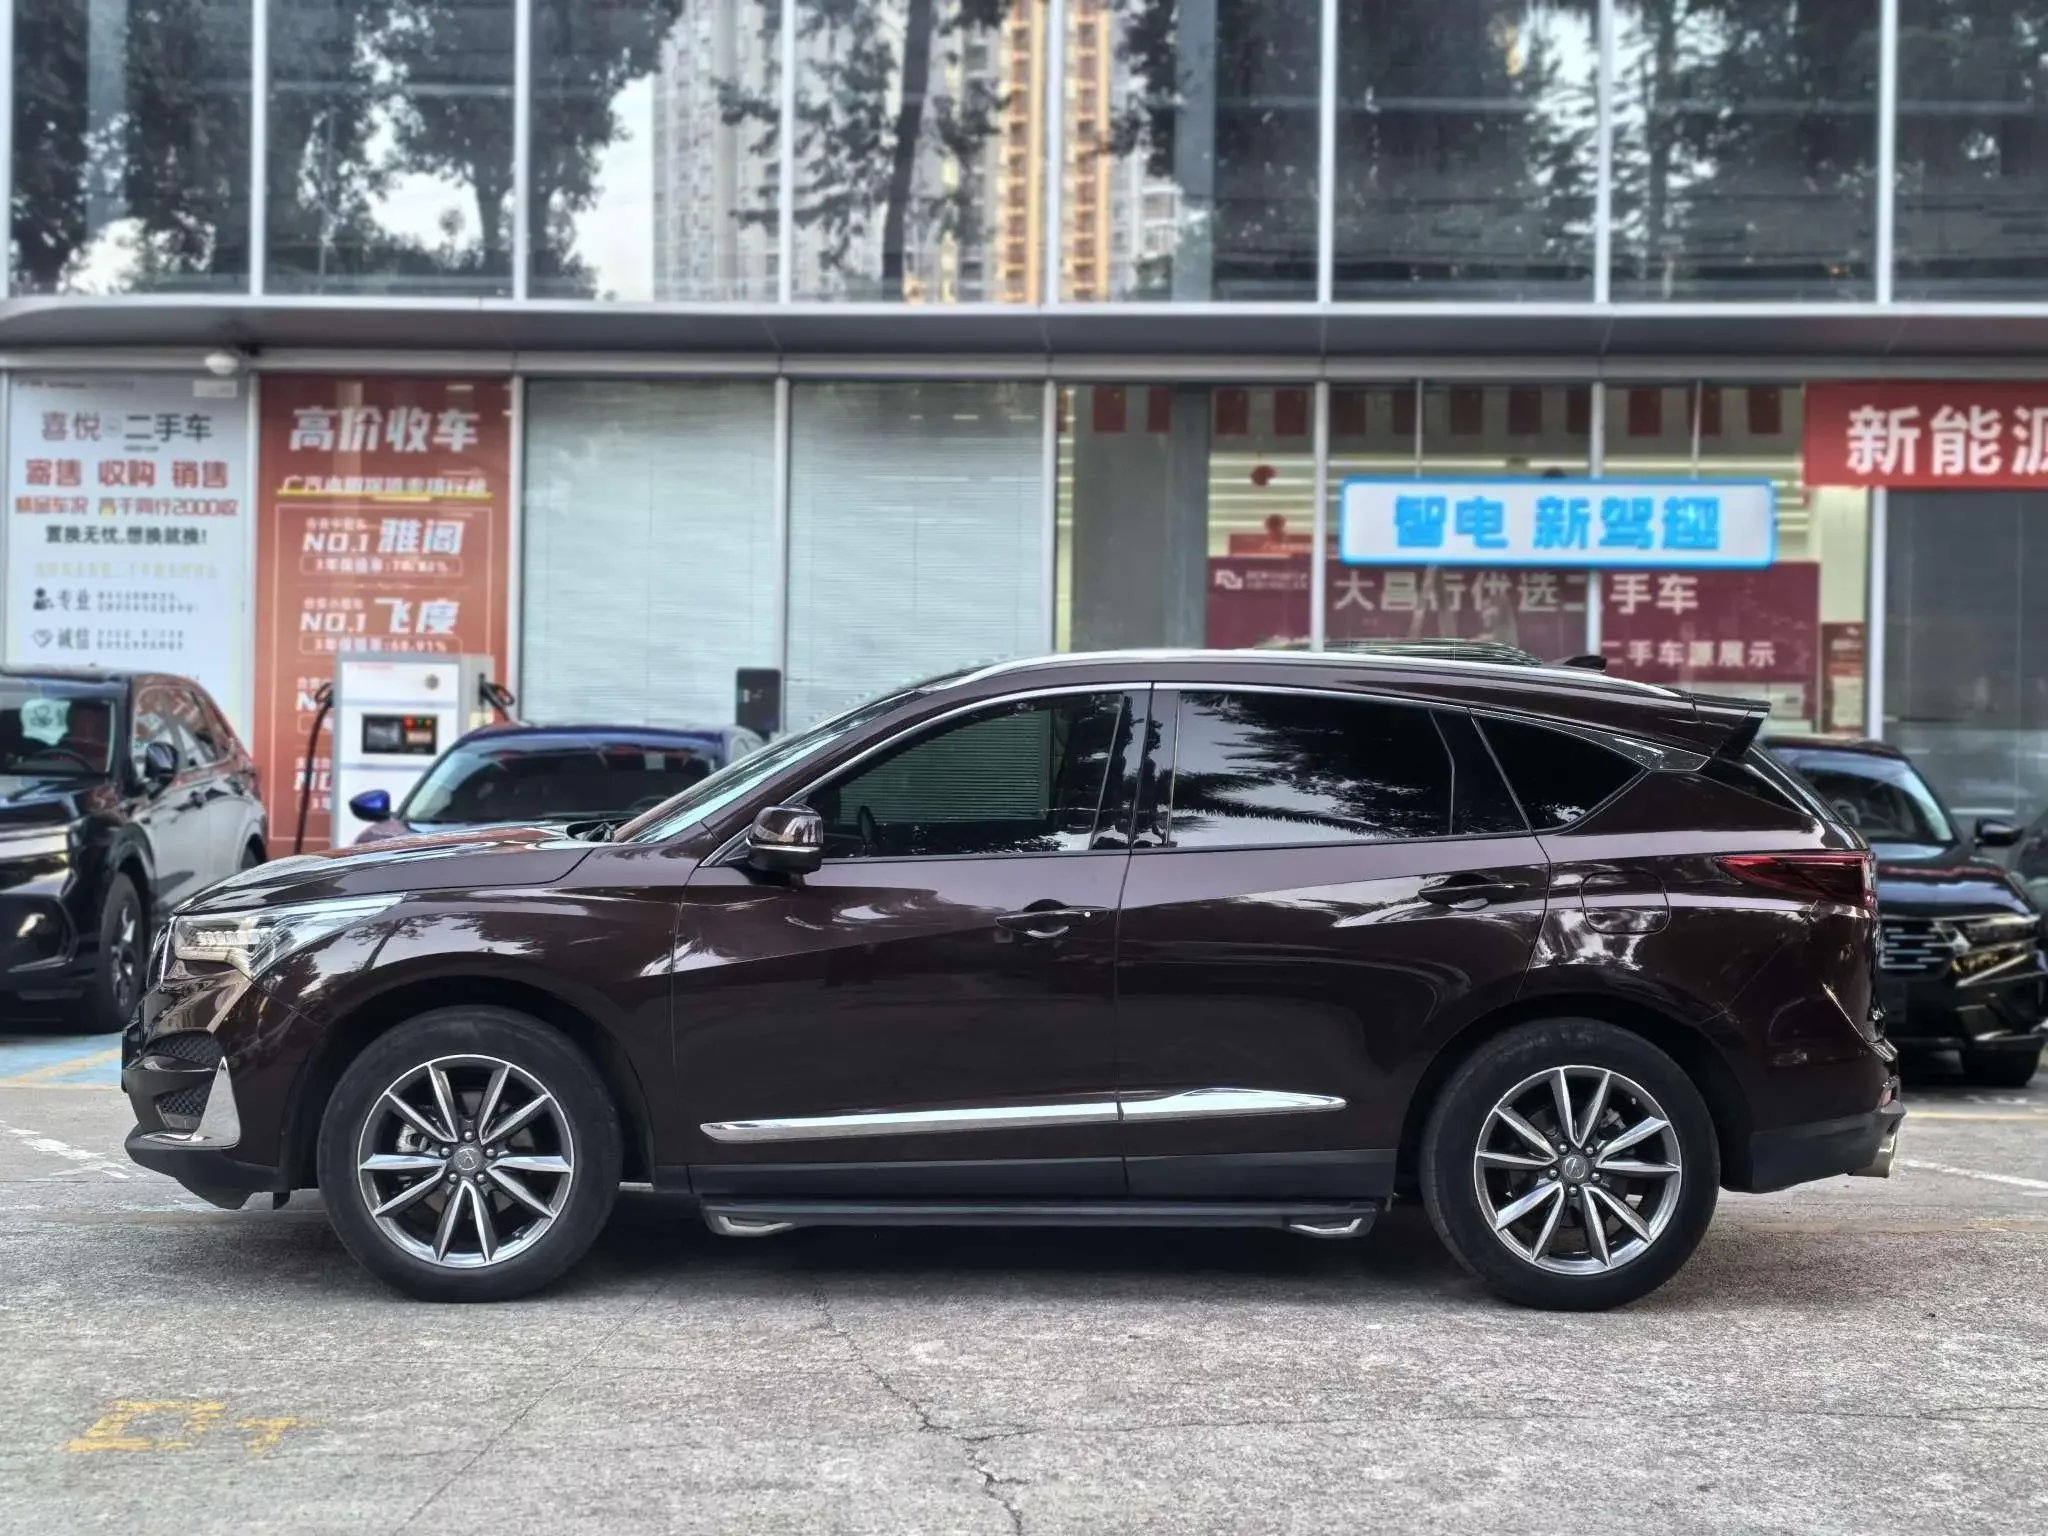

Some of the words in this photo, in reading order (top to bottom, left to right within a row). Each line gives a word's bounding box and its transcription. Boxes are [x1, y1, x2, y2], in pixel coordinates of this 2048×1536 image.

[41, 411, 101, 442] 喜悦
[124, 413, 213, 443] 二手车
[289, 405, 480, 452] 高价收车
[98, 459, 156, 487] 收购
[171, 461, 229, 488] 销售
[302, 532, 370, 553] NO.1
[377, 516, 466, 556] 雅阁
[1393, 494, 1509, 549] 智电
[1532, 494, 1721, 549] 新驾趣
[300, 612, 368, 633] NO.1
[374, 596, 461, 635] 飞度
